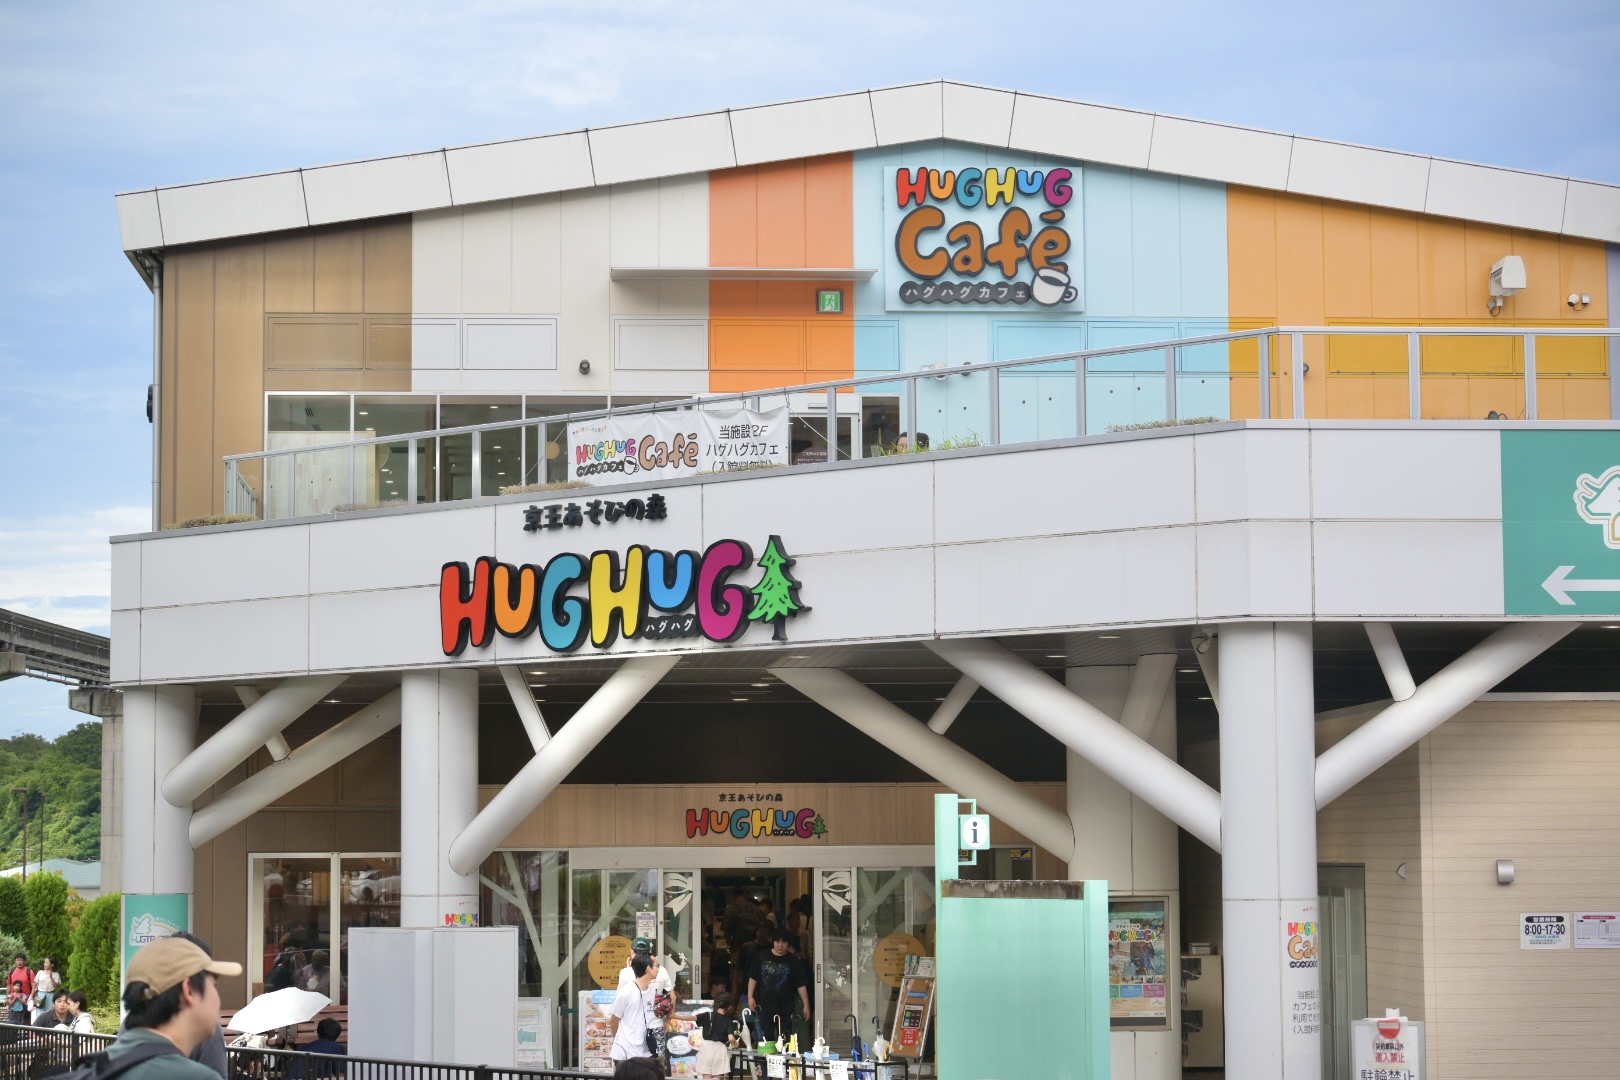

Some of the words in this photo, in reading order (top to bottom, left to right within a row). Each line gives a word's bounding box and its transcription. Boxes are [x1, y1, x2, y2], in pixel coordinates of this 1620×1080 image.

[896, 167, 1073, 208] HUGHUG
[895, 205, 1072, 280] Café
[905, 286, 1026, 299] ハグハグカフェ
[719, 424, 769, 440] 当施設2F
[576, 438, 637, 465] HUGHUG
[638, 433, 699, 471] Café
[706, 442, 779, 457] ハグハグカフェ
[523, 493, 668, 532] 京王あそびの森
[440, 539, 753, 657] HUGHUG
[645, 618, 694, 633] ハグハグ
[718, 793, 784, 802] 京王あそびの森
[686, 807, 815, 839] HUGHUG
[1288, 922, 1318, 936] HUGH
[1288, 935, 1319, 960] Caf
[1376, 1052, 1405, 1063] 進入禁止
